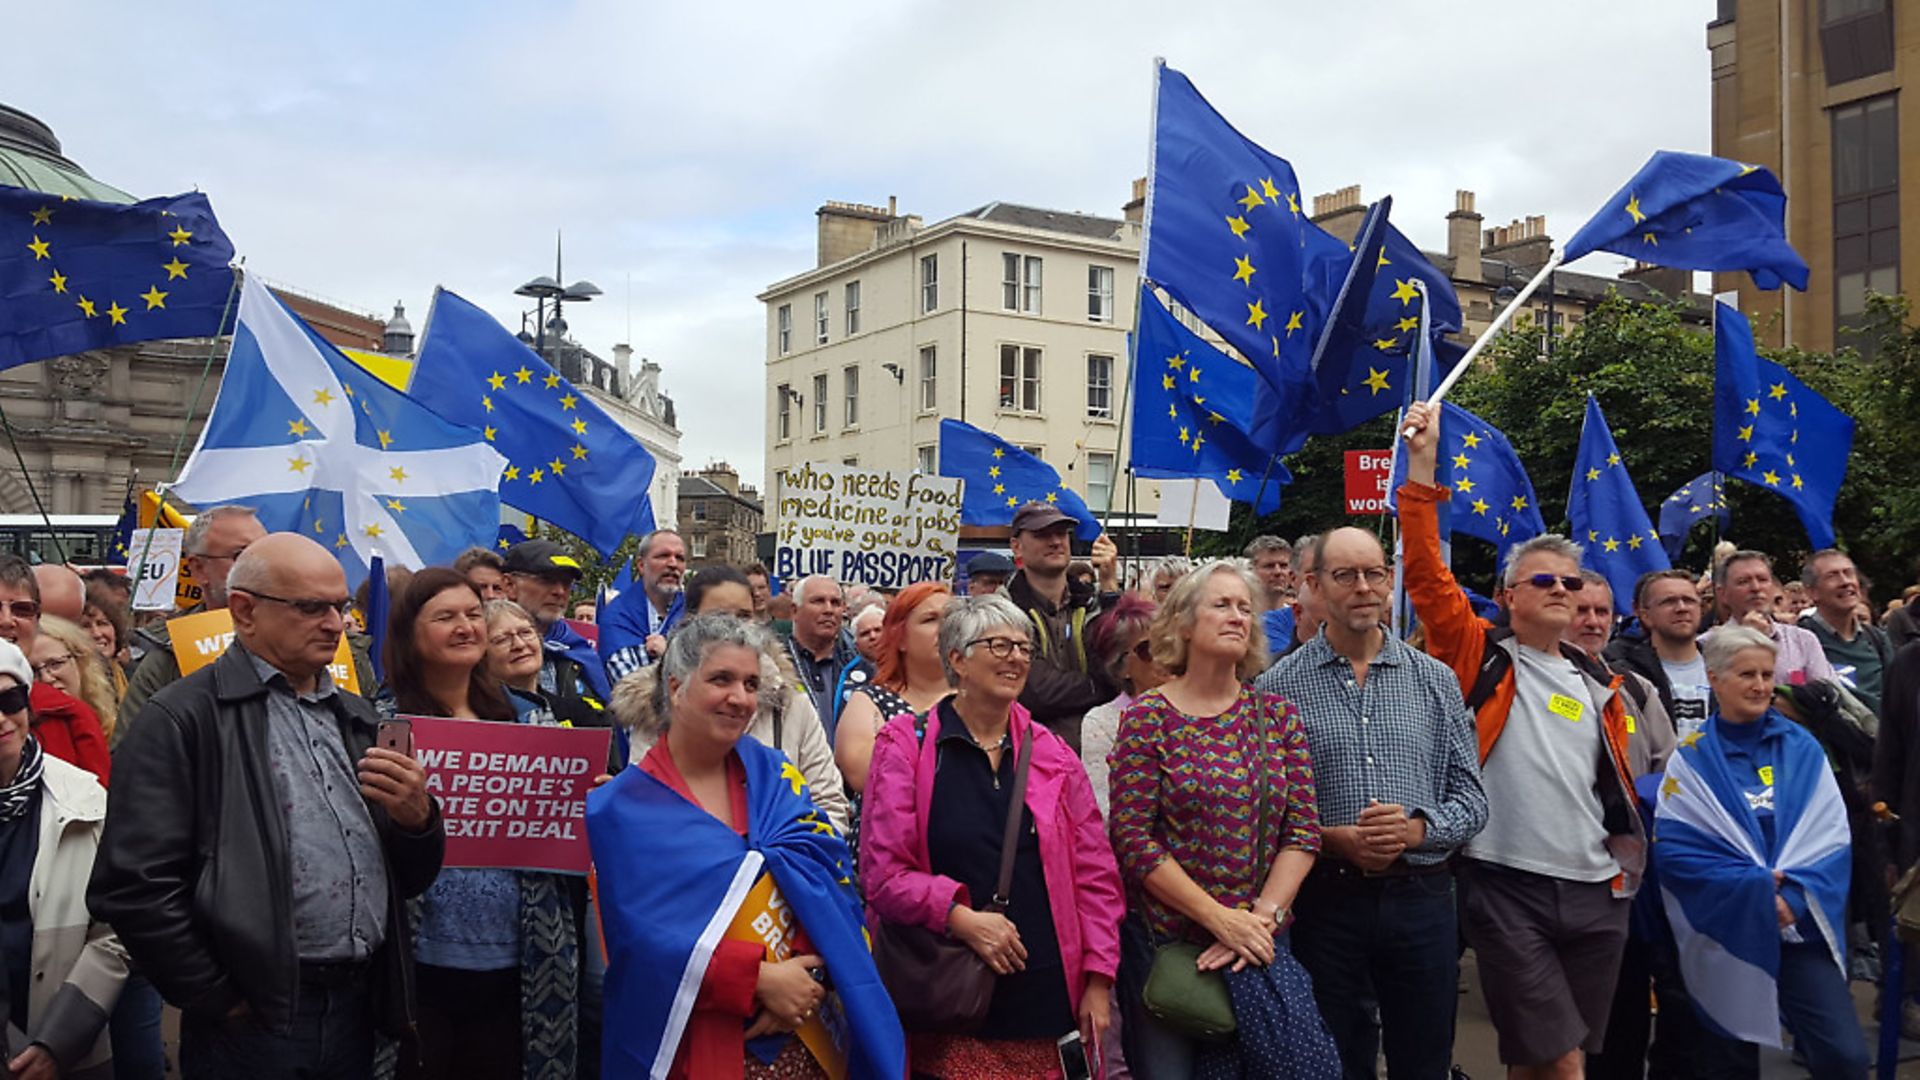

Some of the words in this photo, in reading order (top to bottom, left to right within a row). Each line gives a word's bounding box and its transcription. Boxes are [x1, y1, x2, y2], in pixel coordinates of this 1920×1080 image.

[1359, 454, 1391, 470] Bre
[842, 471, 900, 500] needs
[781, 493, 888, 525] medicine
[892, 515, 912, 528] or
[906, 507, 960, 548] jobs
[780, 520, 798, 544] if
[800, 525, 855, 548] you've
[860, 528, 902, 551] got
[926, 537, 944, 552] a
[140, 563, 165, 579] EU
[417, 749, 462, 769] WE
[468, 752, 589, 775] DEMAND
[425, 773, 444, 791] A
[451, 775, 574, 796] PEOPLE'S
[485, 799, 528, 817] ON
[536, 801, 586, 818] THE
[507, 821, 577, 840] DEAL
